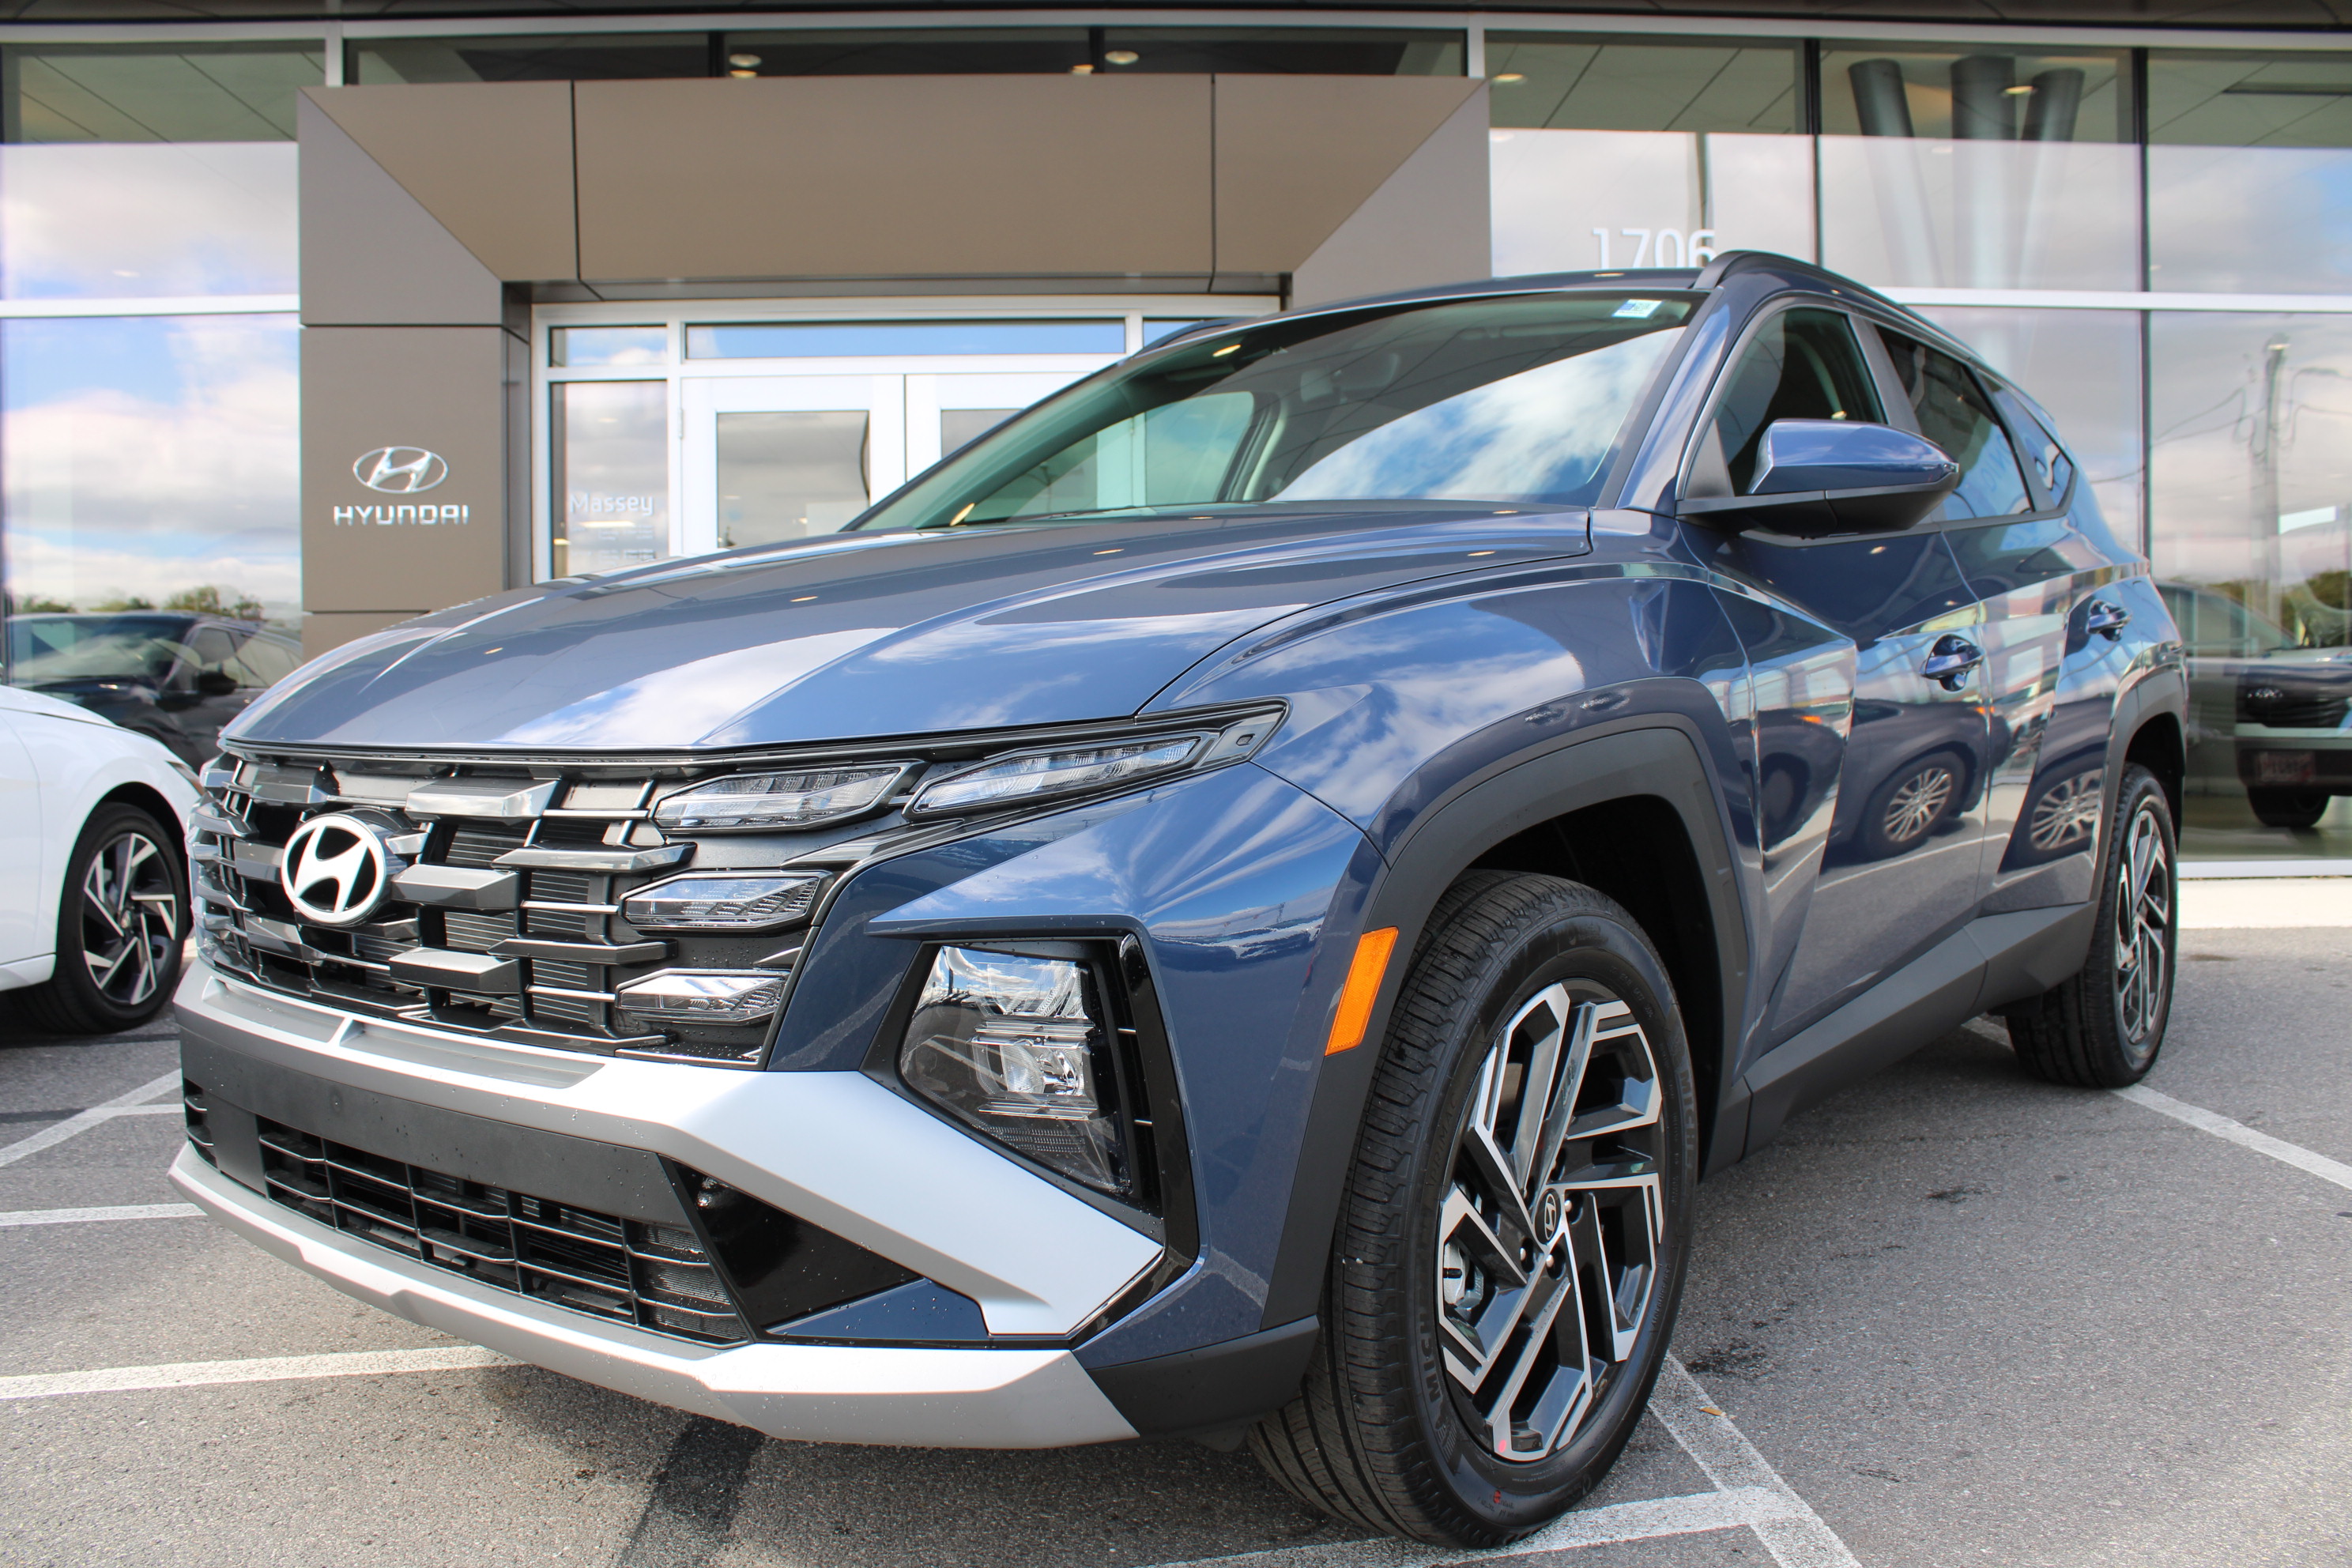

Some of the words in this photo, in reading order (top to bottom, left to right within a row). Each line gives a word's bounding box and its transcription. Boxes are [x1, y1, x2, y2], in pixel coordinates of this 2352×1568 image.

[1592, 227, 1717, 270] 1706
[333, 504, 469, 526] HYUNDAI
[569, 492, 654, 517] Massey
